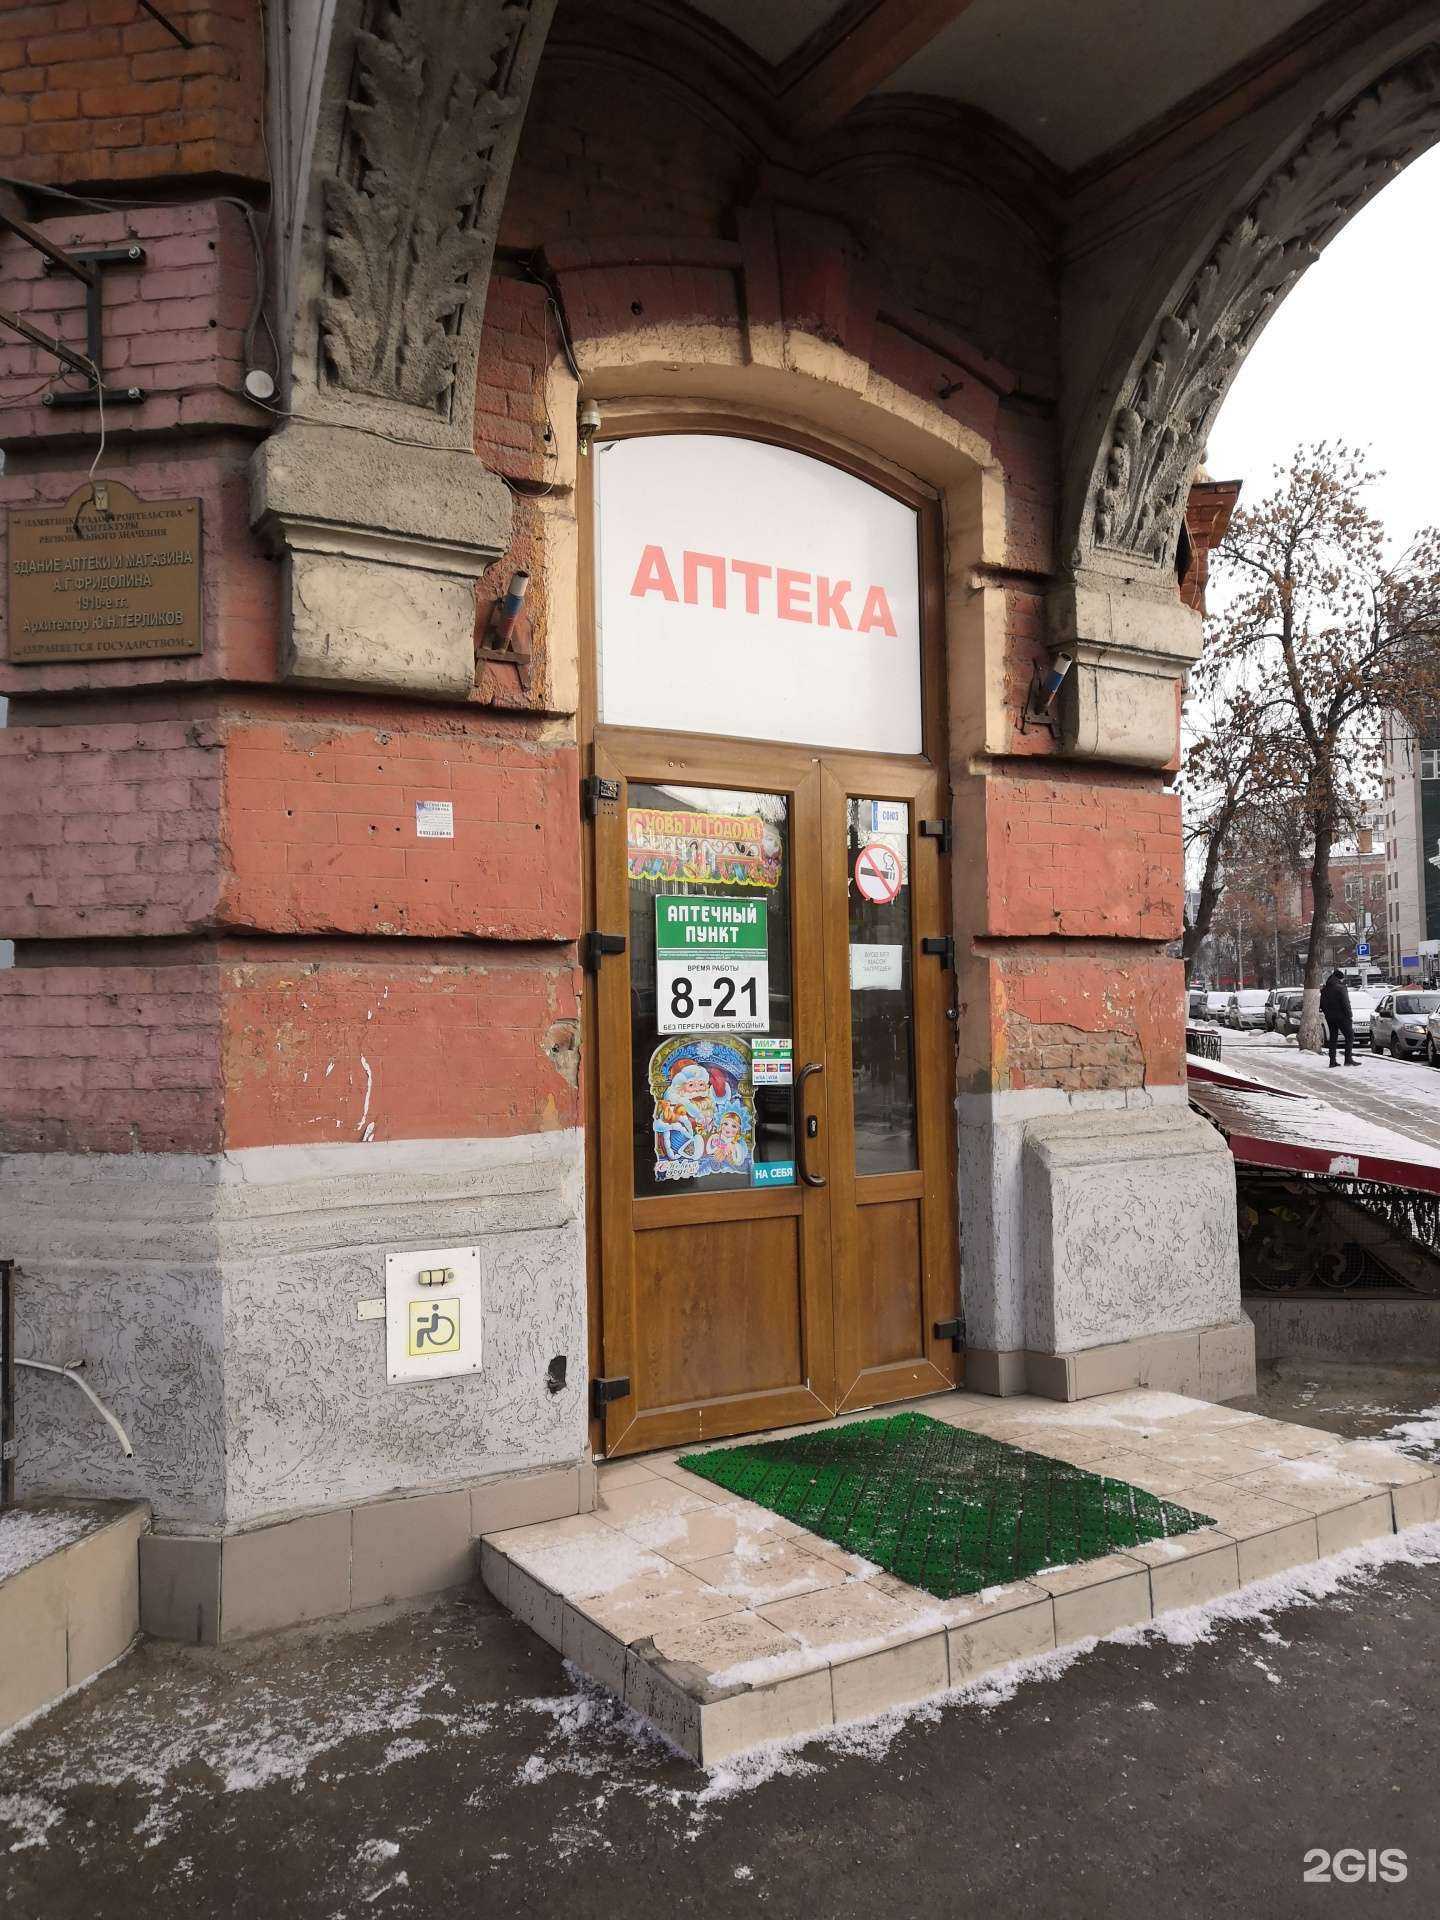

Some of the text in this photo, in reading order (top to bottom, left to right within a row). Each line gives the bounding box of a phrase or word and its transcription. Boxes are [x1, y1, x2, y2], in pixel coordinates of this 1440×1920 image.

[15, 550, 193, 575] ЗДАНИЕ АПТЕКИ И МАГАЗИНА
[630, 544, 898, 637] АПТЕКА
[23, 618, 90, 635] Архитектор
[97, 637, 186, 651] ГОСУДАРСТВОМ
[645, 813, 700, 835] НОВЫМ
[668, 904, 757, 924] АПТЕЧНЫЙ
[685, 926, 739, 943] ПУНКТ
[687, 964, 739, 972] ВРЕМЯ РАБОТЫ
[670, 976, 758, 1018] 8-21
[663, 1023, 676, 1031] БЕЗ
[678, 1022, 720, 1031] ПЕРЕРЫВОВ
[726, 1021, 765, 1030] ВЫХОДНЫХ
[755, 1168, 792, 1179] НА СЕБЯ
